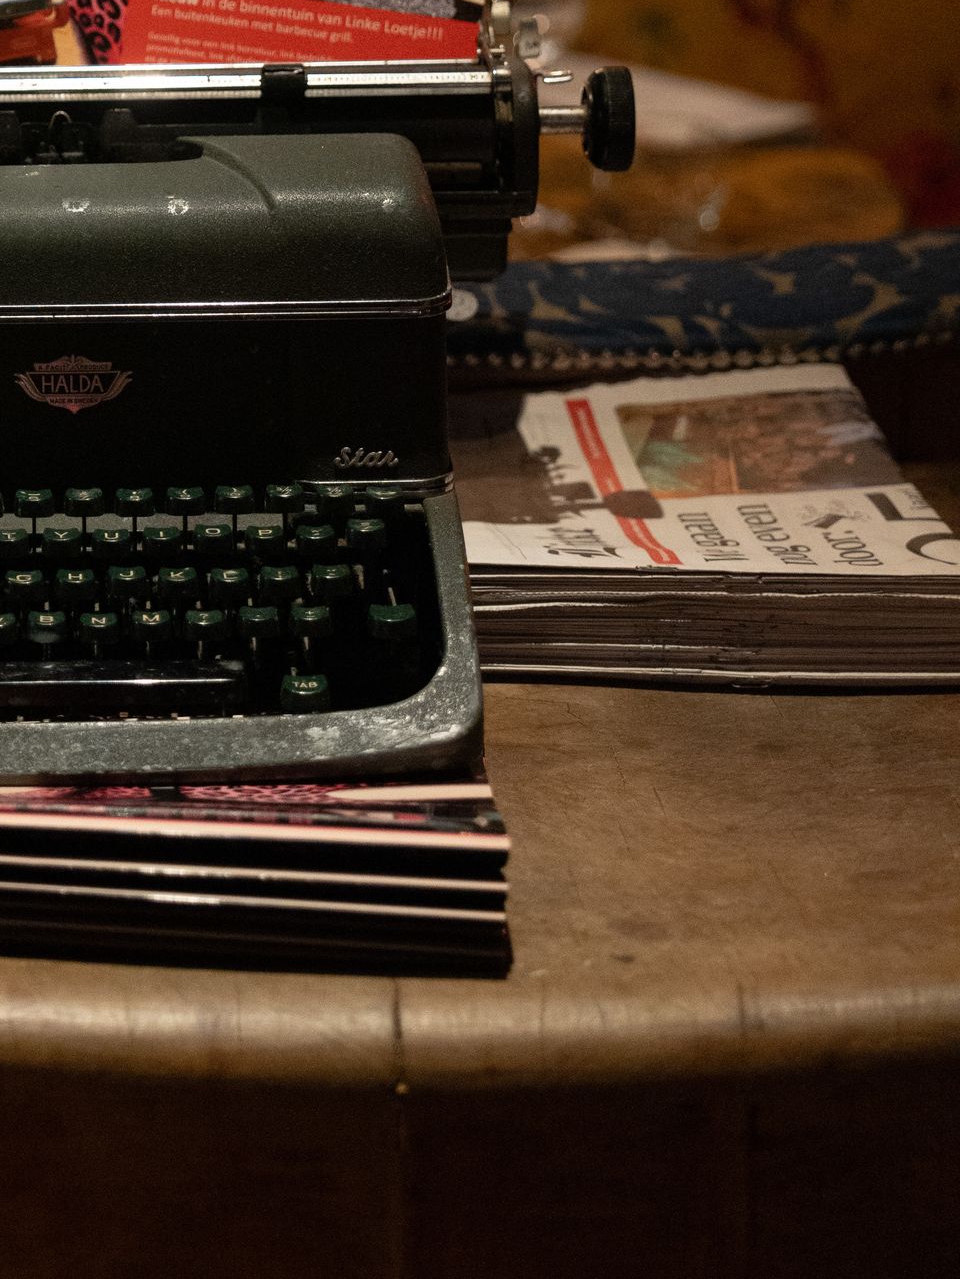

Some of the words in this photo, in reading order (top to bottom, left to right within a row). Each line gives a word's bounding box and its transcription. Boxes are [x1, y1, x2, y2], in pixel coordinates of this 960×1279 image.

[239, 0, 315, 21] binnentuin
[317, 12, 343, 25] van
[345, 15, 381, 32] Linke
[384, 20, 443, 40] Loetje!!!
[41, 374, 104, 393] HALDA
[334, 446, 400, 469] Star
[676, 511, 741, 548] gaan
[737, 503, 791, 543] even
